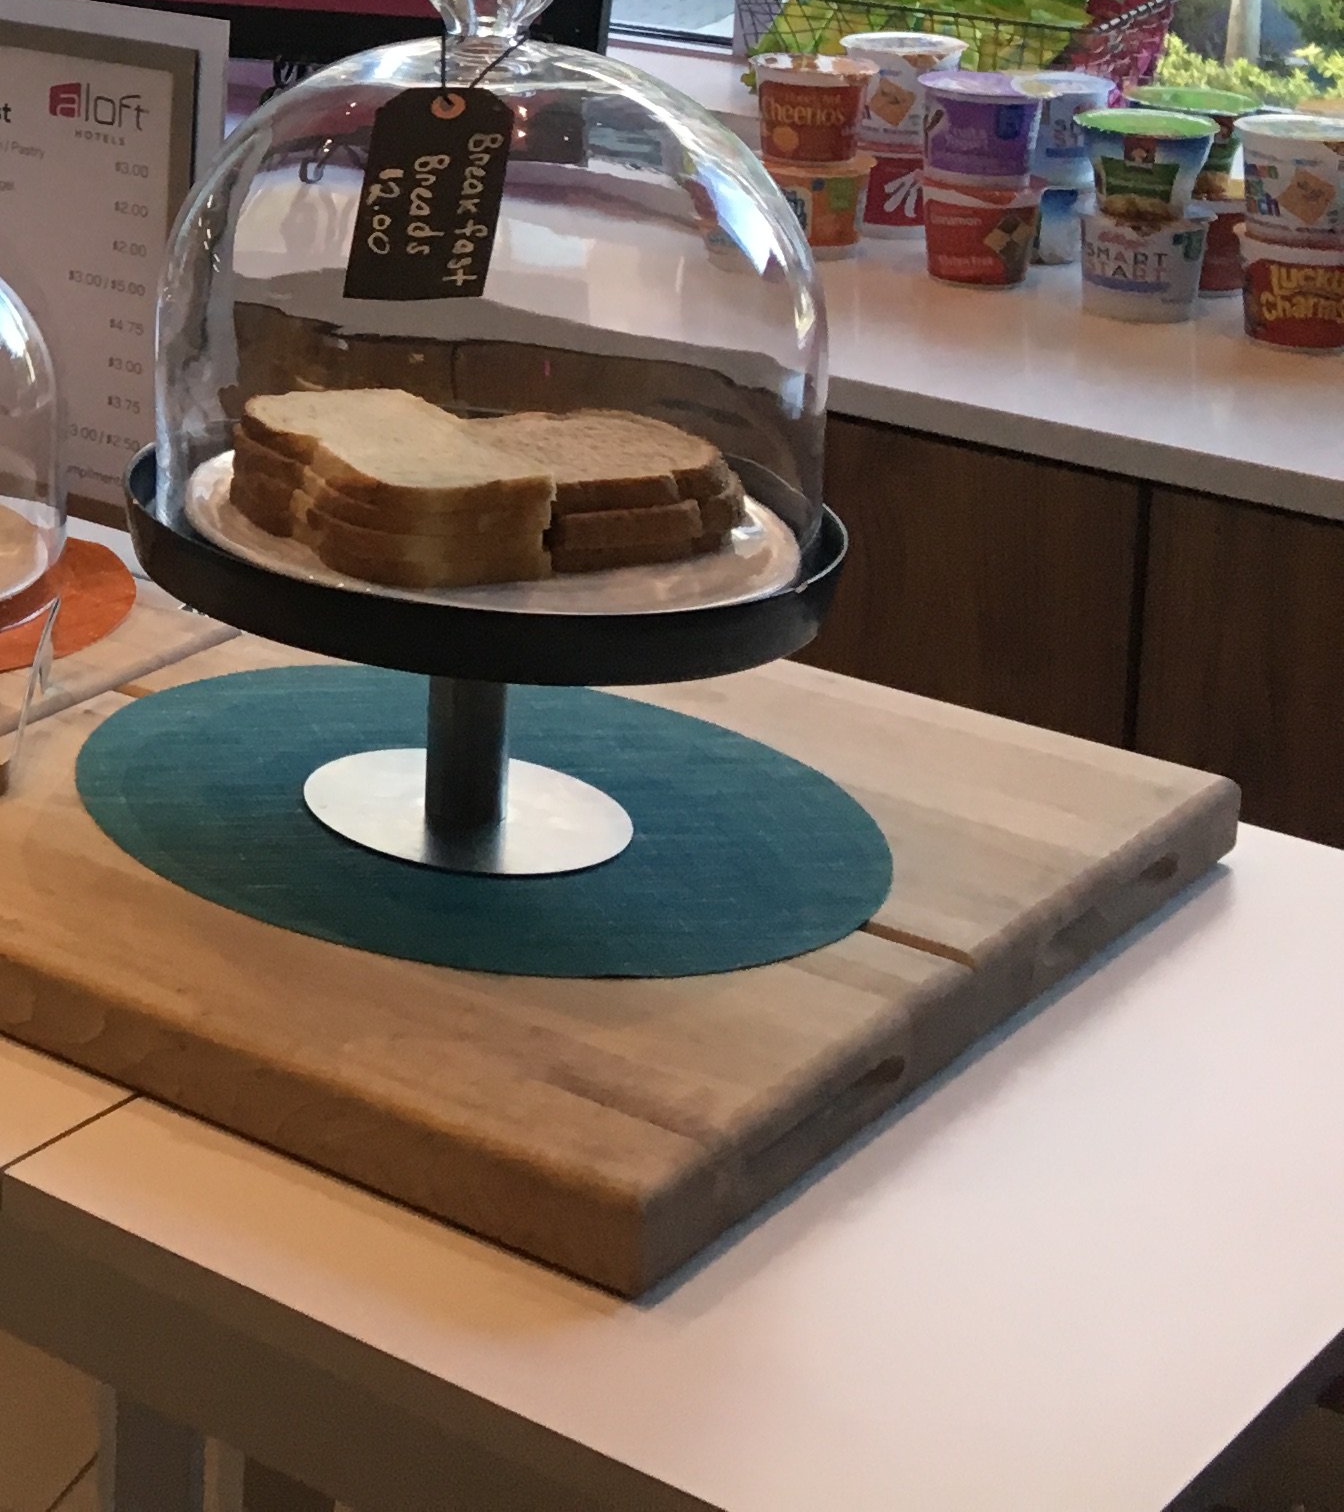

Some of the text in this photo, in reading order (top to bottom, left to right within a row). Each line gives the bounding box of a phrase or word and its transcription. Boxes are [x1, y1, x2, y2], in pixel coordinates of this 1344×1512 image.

[50, 83, 150, 132] aloft
[762, 96, 846, 126] Cheerios
[75, 129, 126, 147] HOTELS
[115, 162, 149, 179] $3.00
[114, 201, 148, 219] $2.00
[406, 154, 451, 256] Breads
[442, 133, 504, 287] Breakfast
[113, 240, 147, 258] $2.00
[1087, 242, 1168, 266] SMART
